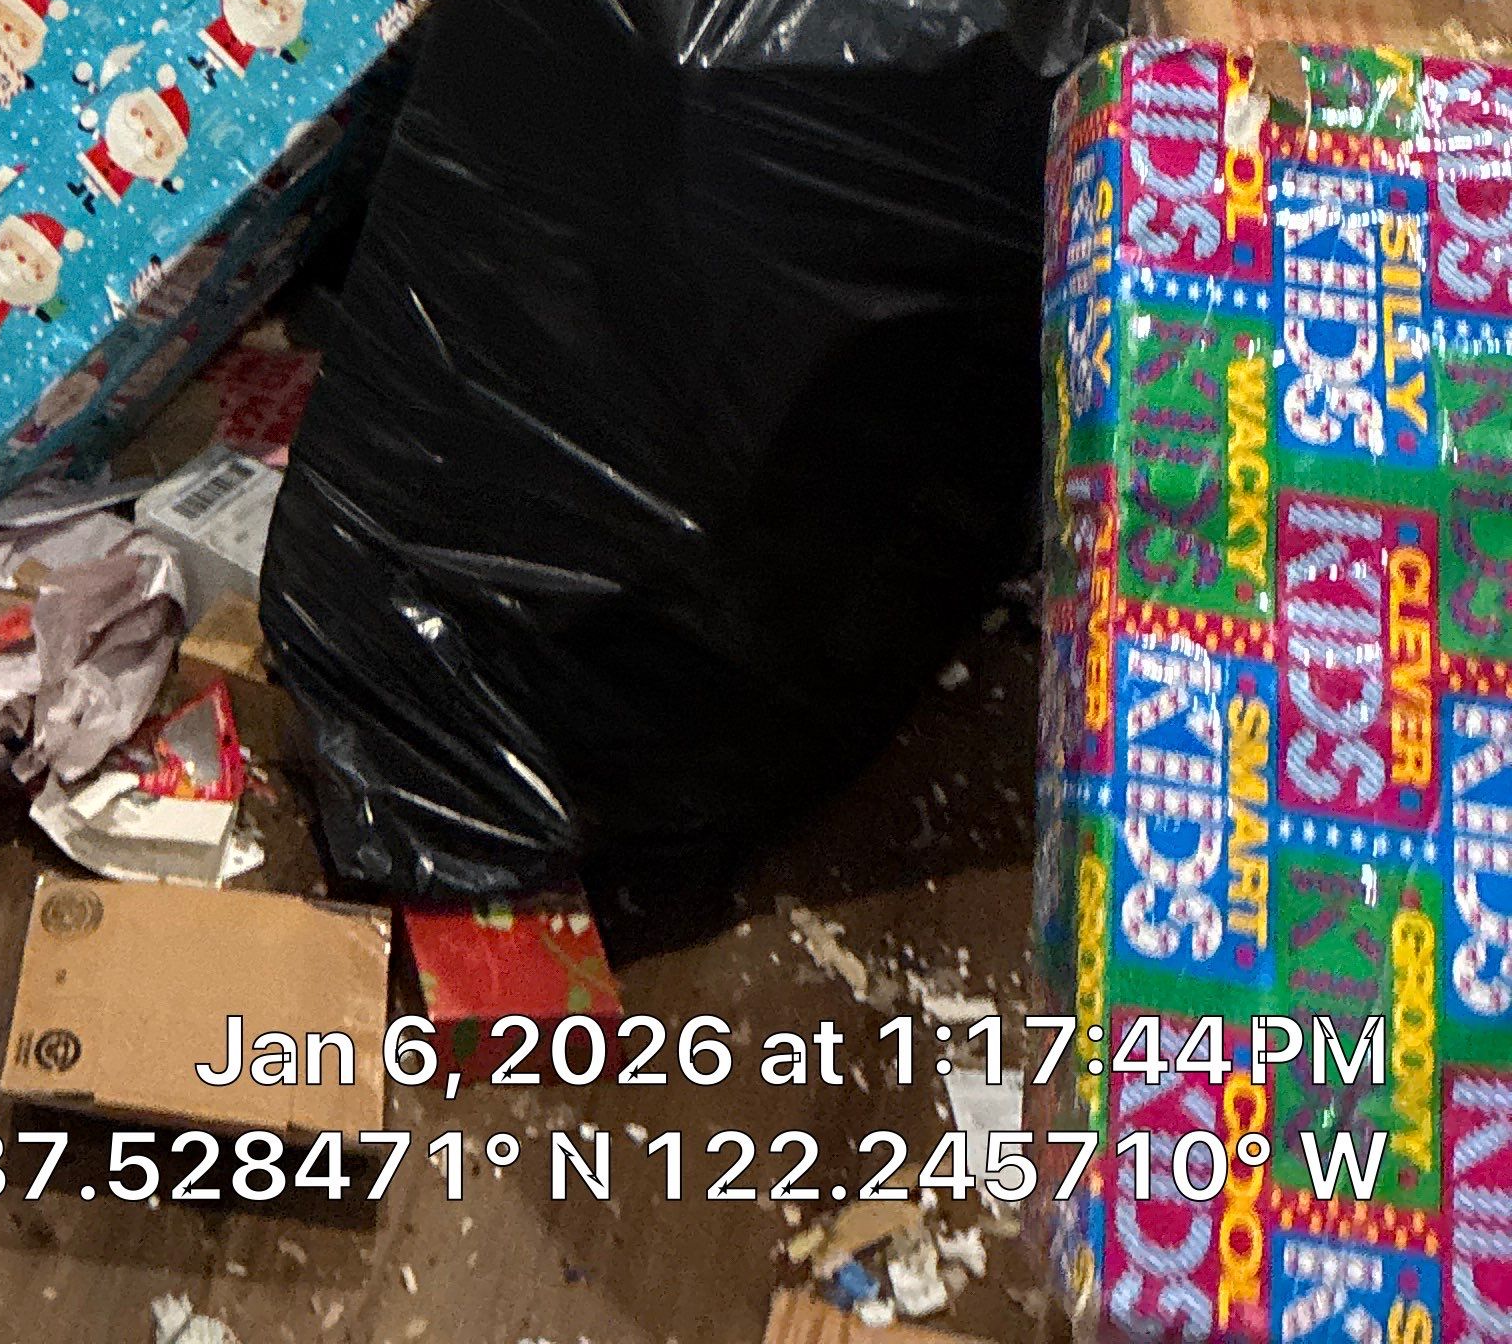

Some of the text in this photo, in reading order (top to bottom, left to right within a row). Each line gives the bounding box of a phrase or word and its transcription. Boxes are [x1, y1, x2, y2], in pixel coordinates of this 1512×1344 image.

[1283, 165, 1384, 458] KIDS
[1380, 212, 1428, 434] SILLY
[1128, 310, 1222, 591] KIDS
[1227, 356, 1270, 586] WACKY
[1286, 501, 1386, 809] KIDS
[1388, 546, 1433, 788] CLEVER
[1121, 646, 1226, 962] KIDS
[1227, 696, 1269, 949] SMART
[1390, 912, 1436, 1173] GROOVY
